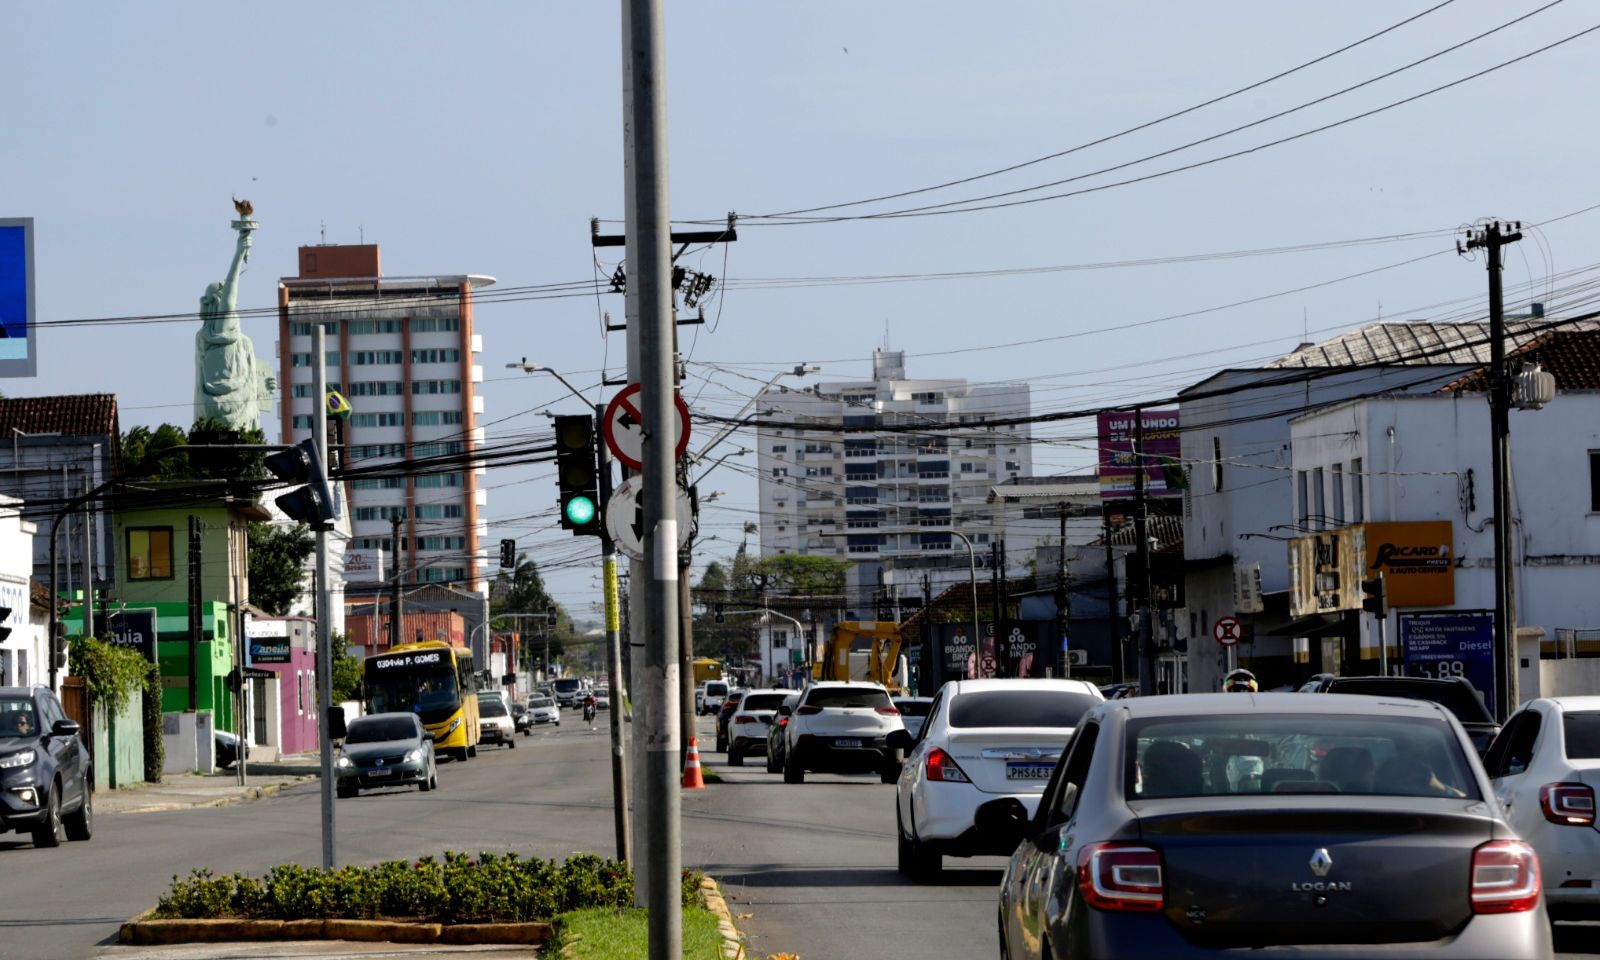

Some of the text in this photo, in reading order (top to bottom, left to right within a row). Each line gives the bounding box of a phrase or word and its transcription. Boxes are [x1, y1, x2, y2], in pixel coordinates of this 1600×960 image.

[1109, 420, 1128, 430] UM
[944, 644, 976, 654] BRANDO
[1459, 640, 1491, 650] Diesel
[414, 653, 440, 664] GOMES
[952, 653, 968, 662] BIKE
[1291, 881, 1352, 891] LOGAN
